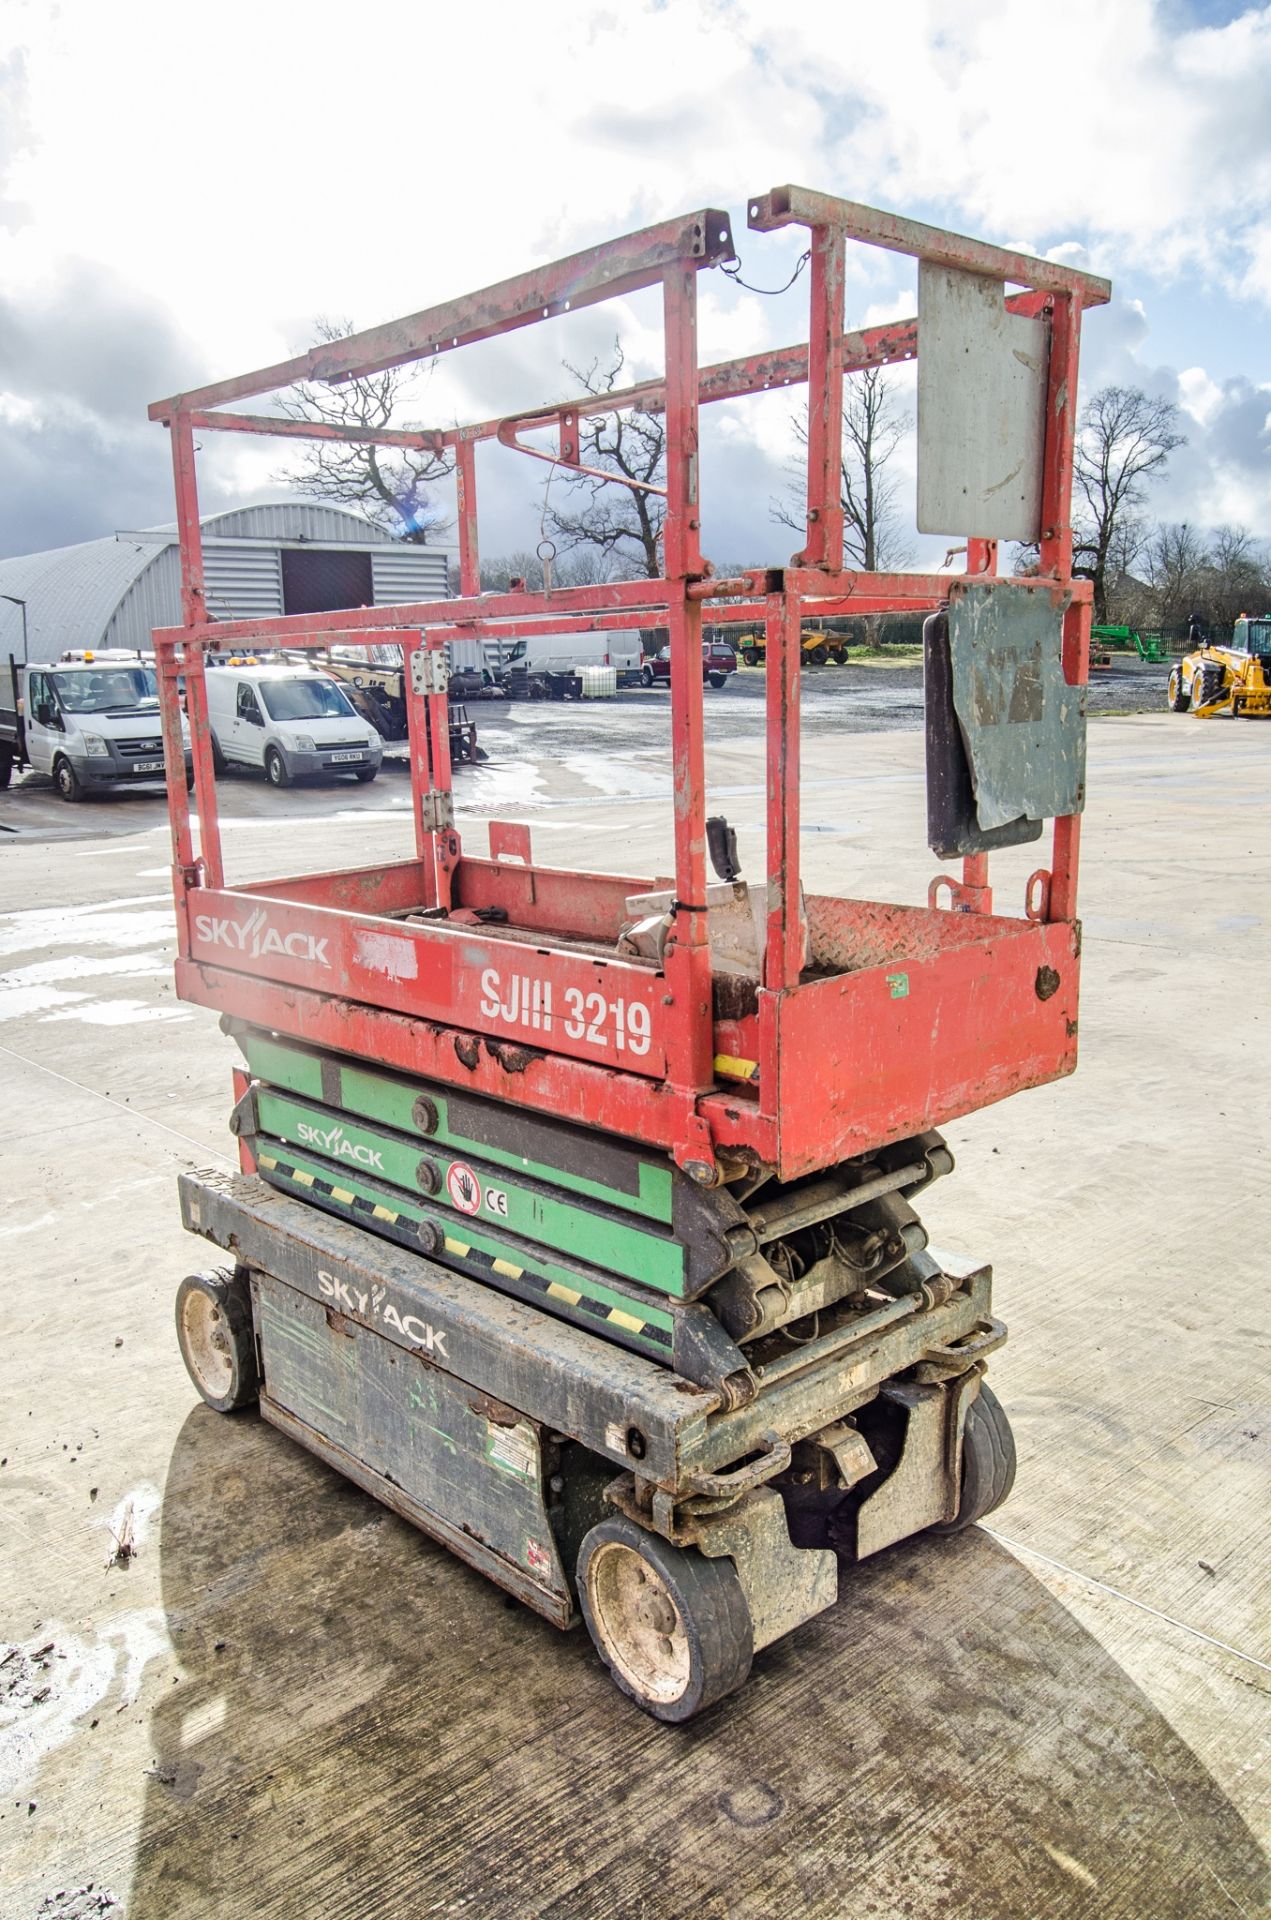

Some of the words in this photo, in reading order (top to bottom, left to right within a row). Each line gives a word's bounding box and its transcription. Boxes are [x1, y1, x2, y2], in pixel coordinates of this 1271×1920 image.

[195, 907, 332, 969] SKYJACK
[564, 988, 652, 1056] 3219
[297, 1123, 384, 1171] SKYJACK
[486, 1189, 506, 1214] CE
